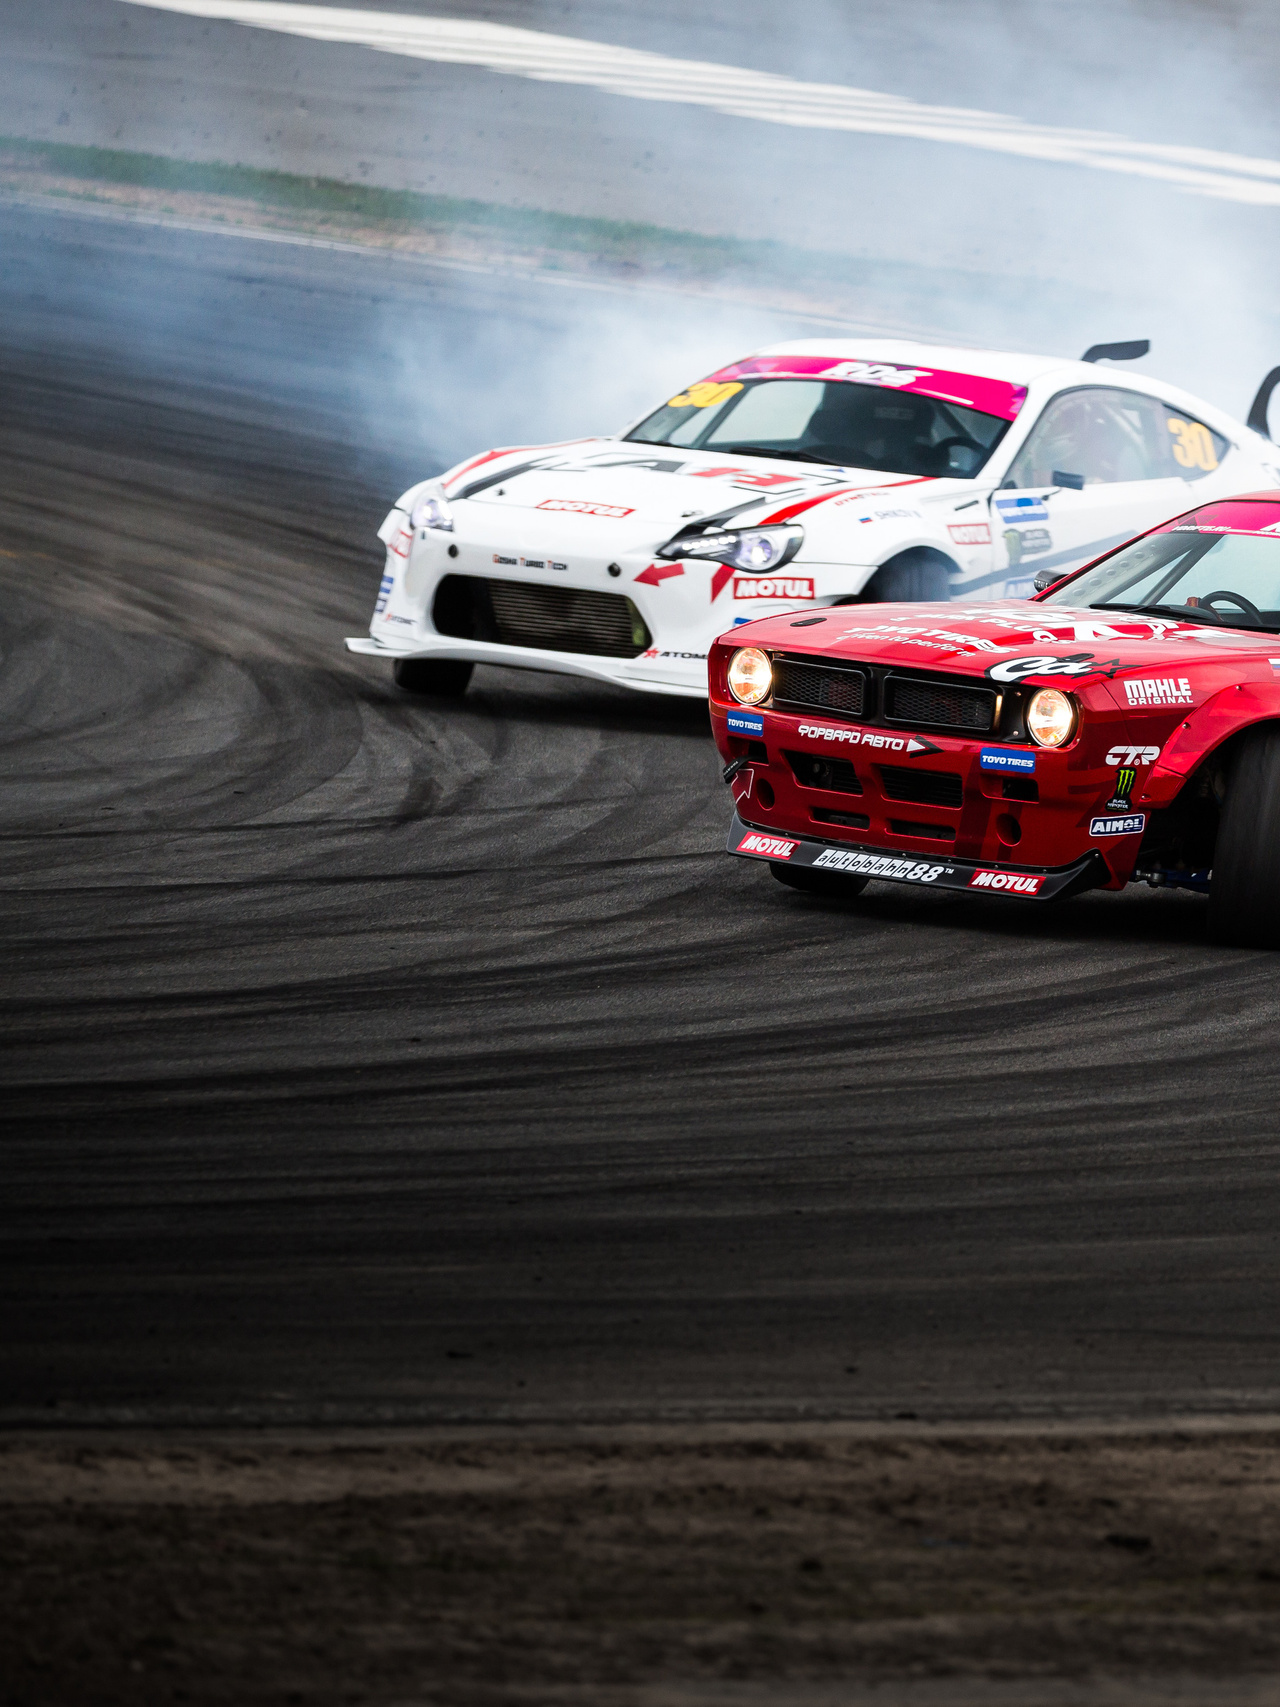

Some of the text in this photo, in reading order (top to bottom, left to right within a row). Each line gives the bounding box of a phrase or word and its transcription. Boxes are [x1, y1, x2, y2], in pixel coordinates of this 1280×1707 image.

[819, 361, 934, 388] RDS
[667, 382, 745, 408] 30
[1166, 417, 1220, 472] 30
[539, 500, 630, 517] MOTUL
[735, 579, 813, 598] MOTUL
[1123, 678, 1193, 699] MAHLE
[1128, 695, 1194, 706] ORIGINAL
[727, 718, 763, 731] TOYO TIRES
[982, 755, 1034, 768] TOYO TIRES
[1091, 818, 1142, 833] AIMOL
[740, 835, 795, 858] MOTUL
[811, 848, 944, 883] autobahn88
[970, 872, 1040, 893] MOTUL
